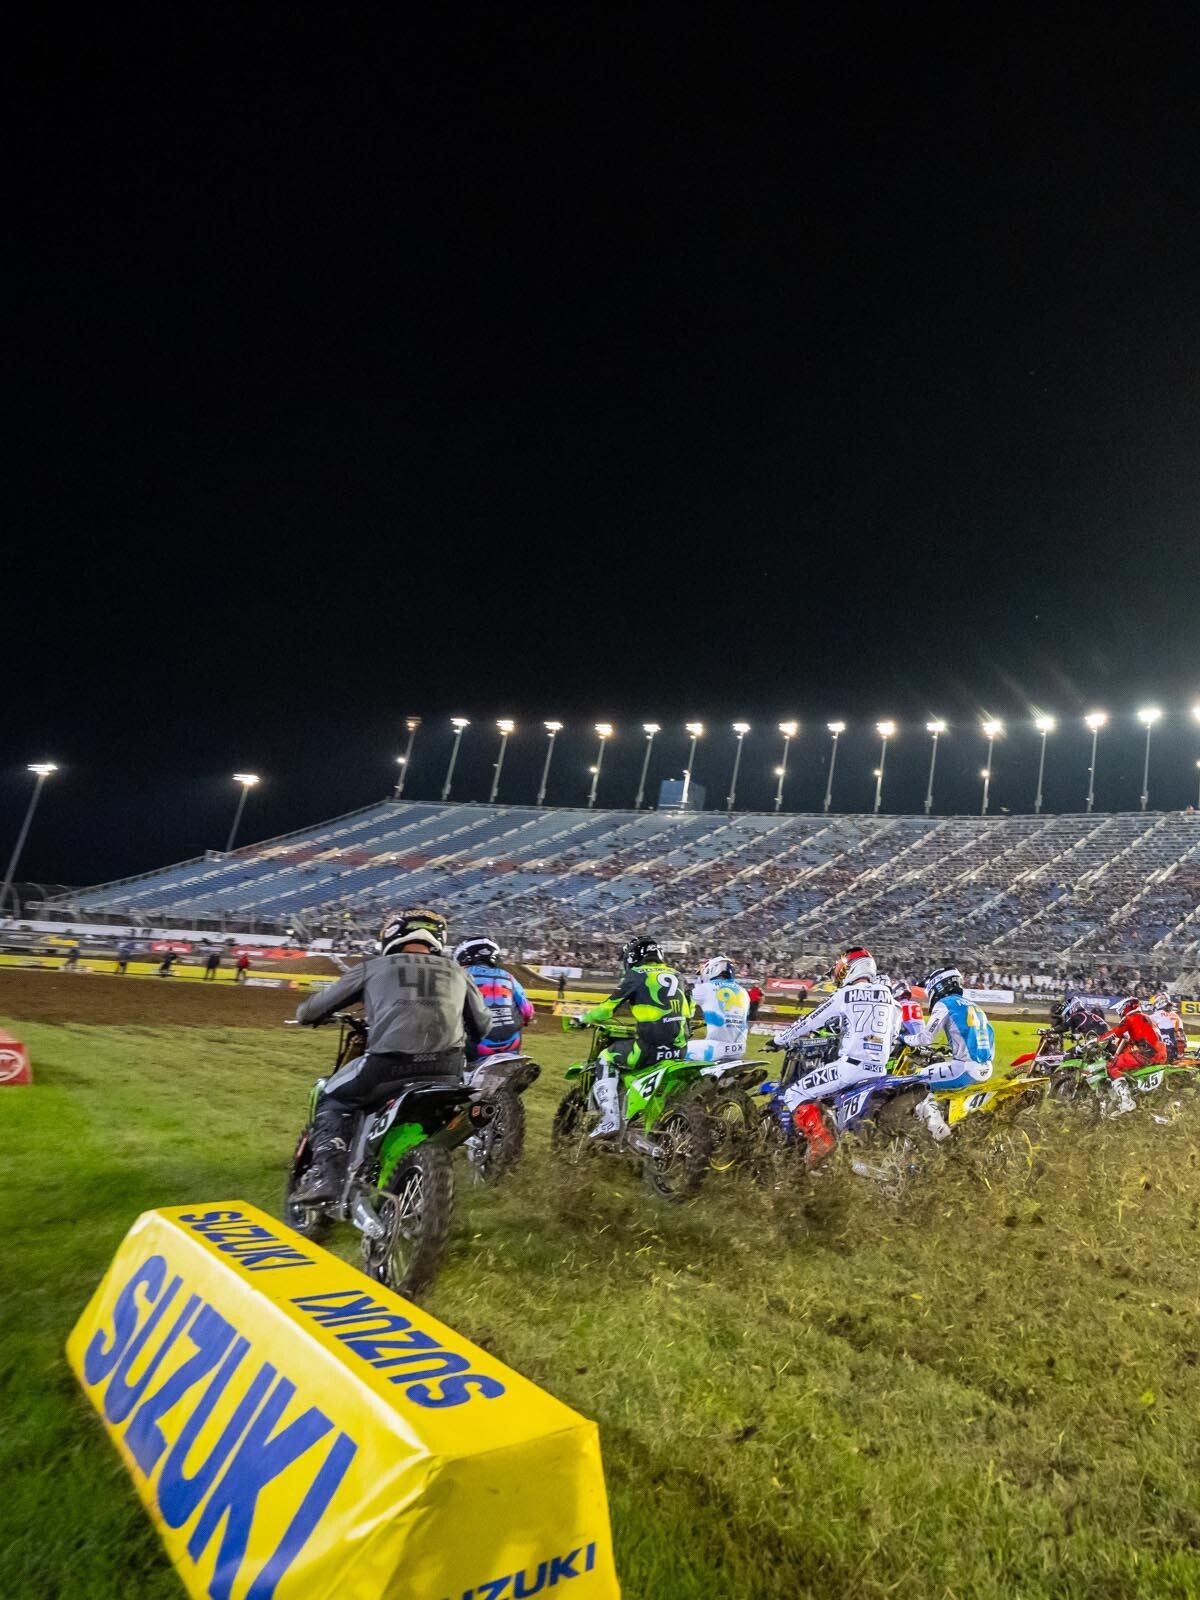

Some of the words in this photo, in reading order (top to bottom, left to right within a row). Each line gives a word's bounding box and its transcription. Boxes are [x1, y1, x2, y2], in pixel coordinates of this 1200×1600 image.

[657, 973, 679, 997] 9
[849, 990, 892, 1004] HARLAN
[852, 1003, 889, 1034] 78
[902, 1005, 923, 1022] 18
[656, 1050, 681, 1061] FOX
[725, 1045, 743, 1053] FOX
[1143, 1073, 1159, 1089] 45
[843, 1096, 860, 1118] 78
[178, 1211, 317, 1271] SUZUKI
[289, 1290, 506, 1409] SUZUKI
[84, 1255, 359, 1600] SUZUKI
[440, 1541, 596, 1600] ZUKI
